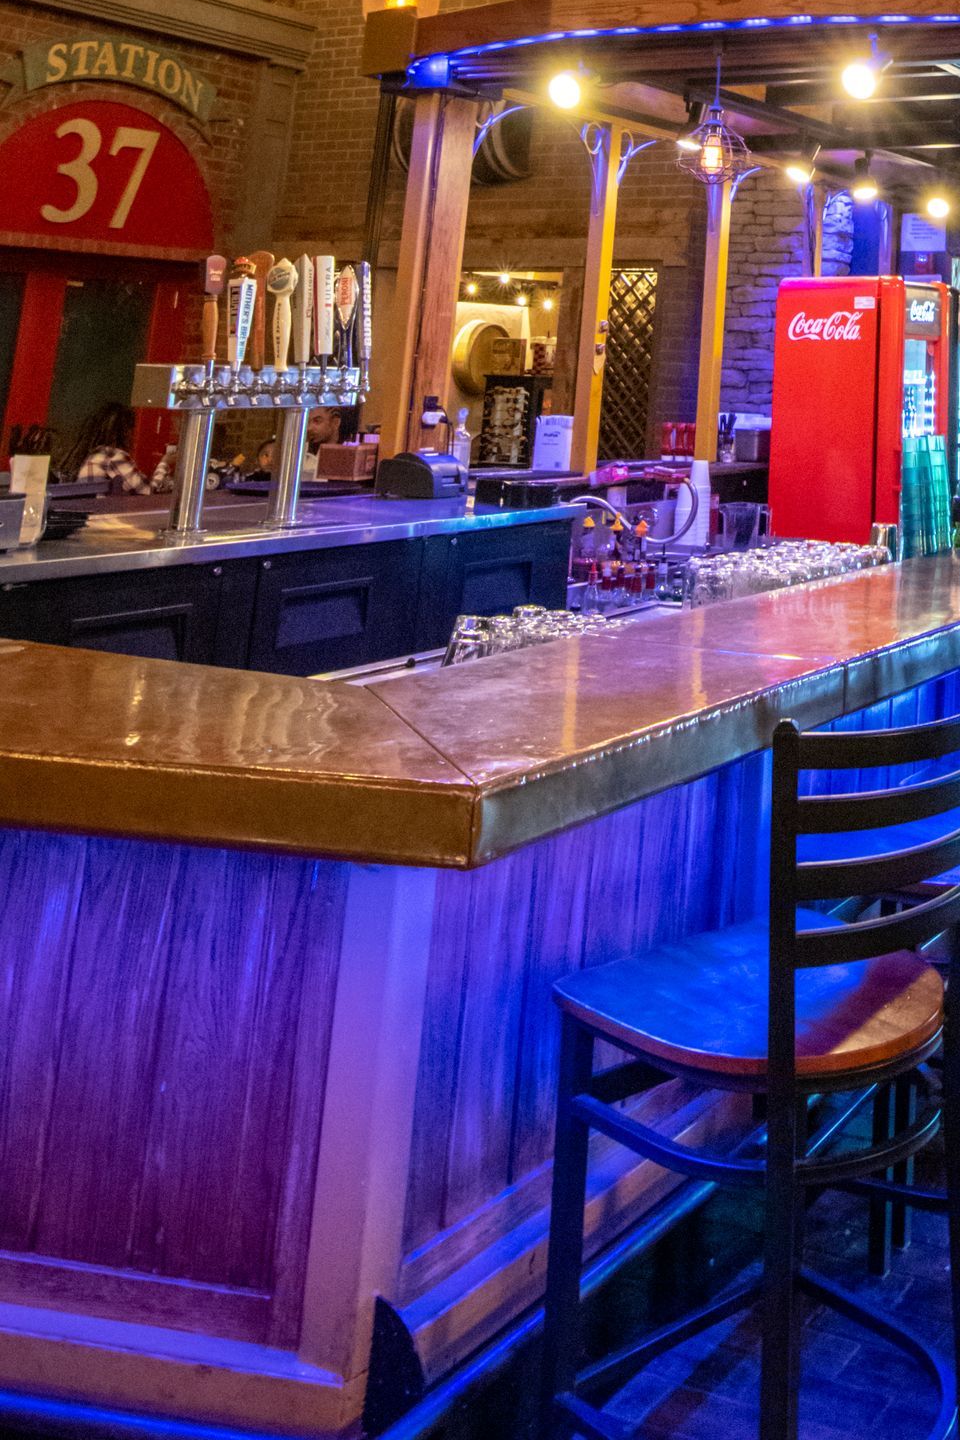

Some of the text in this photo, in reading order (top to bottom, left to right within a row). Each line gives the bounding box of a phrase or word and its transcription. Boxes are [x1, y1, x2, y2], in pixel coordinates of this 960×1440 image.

[46, 40, 204, 113] STATION
[40, 117, 161, 229] 37
[324, 266, 333, 300] ULTRA
[340, 277, 352, 306] PERONI
[363, 317, 372, 347] BUD
